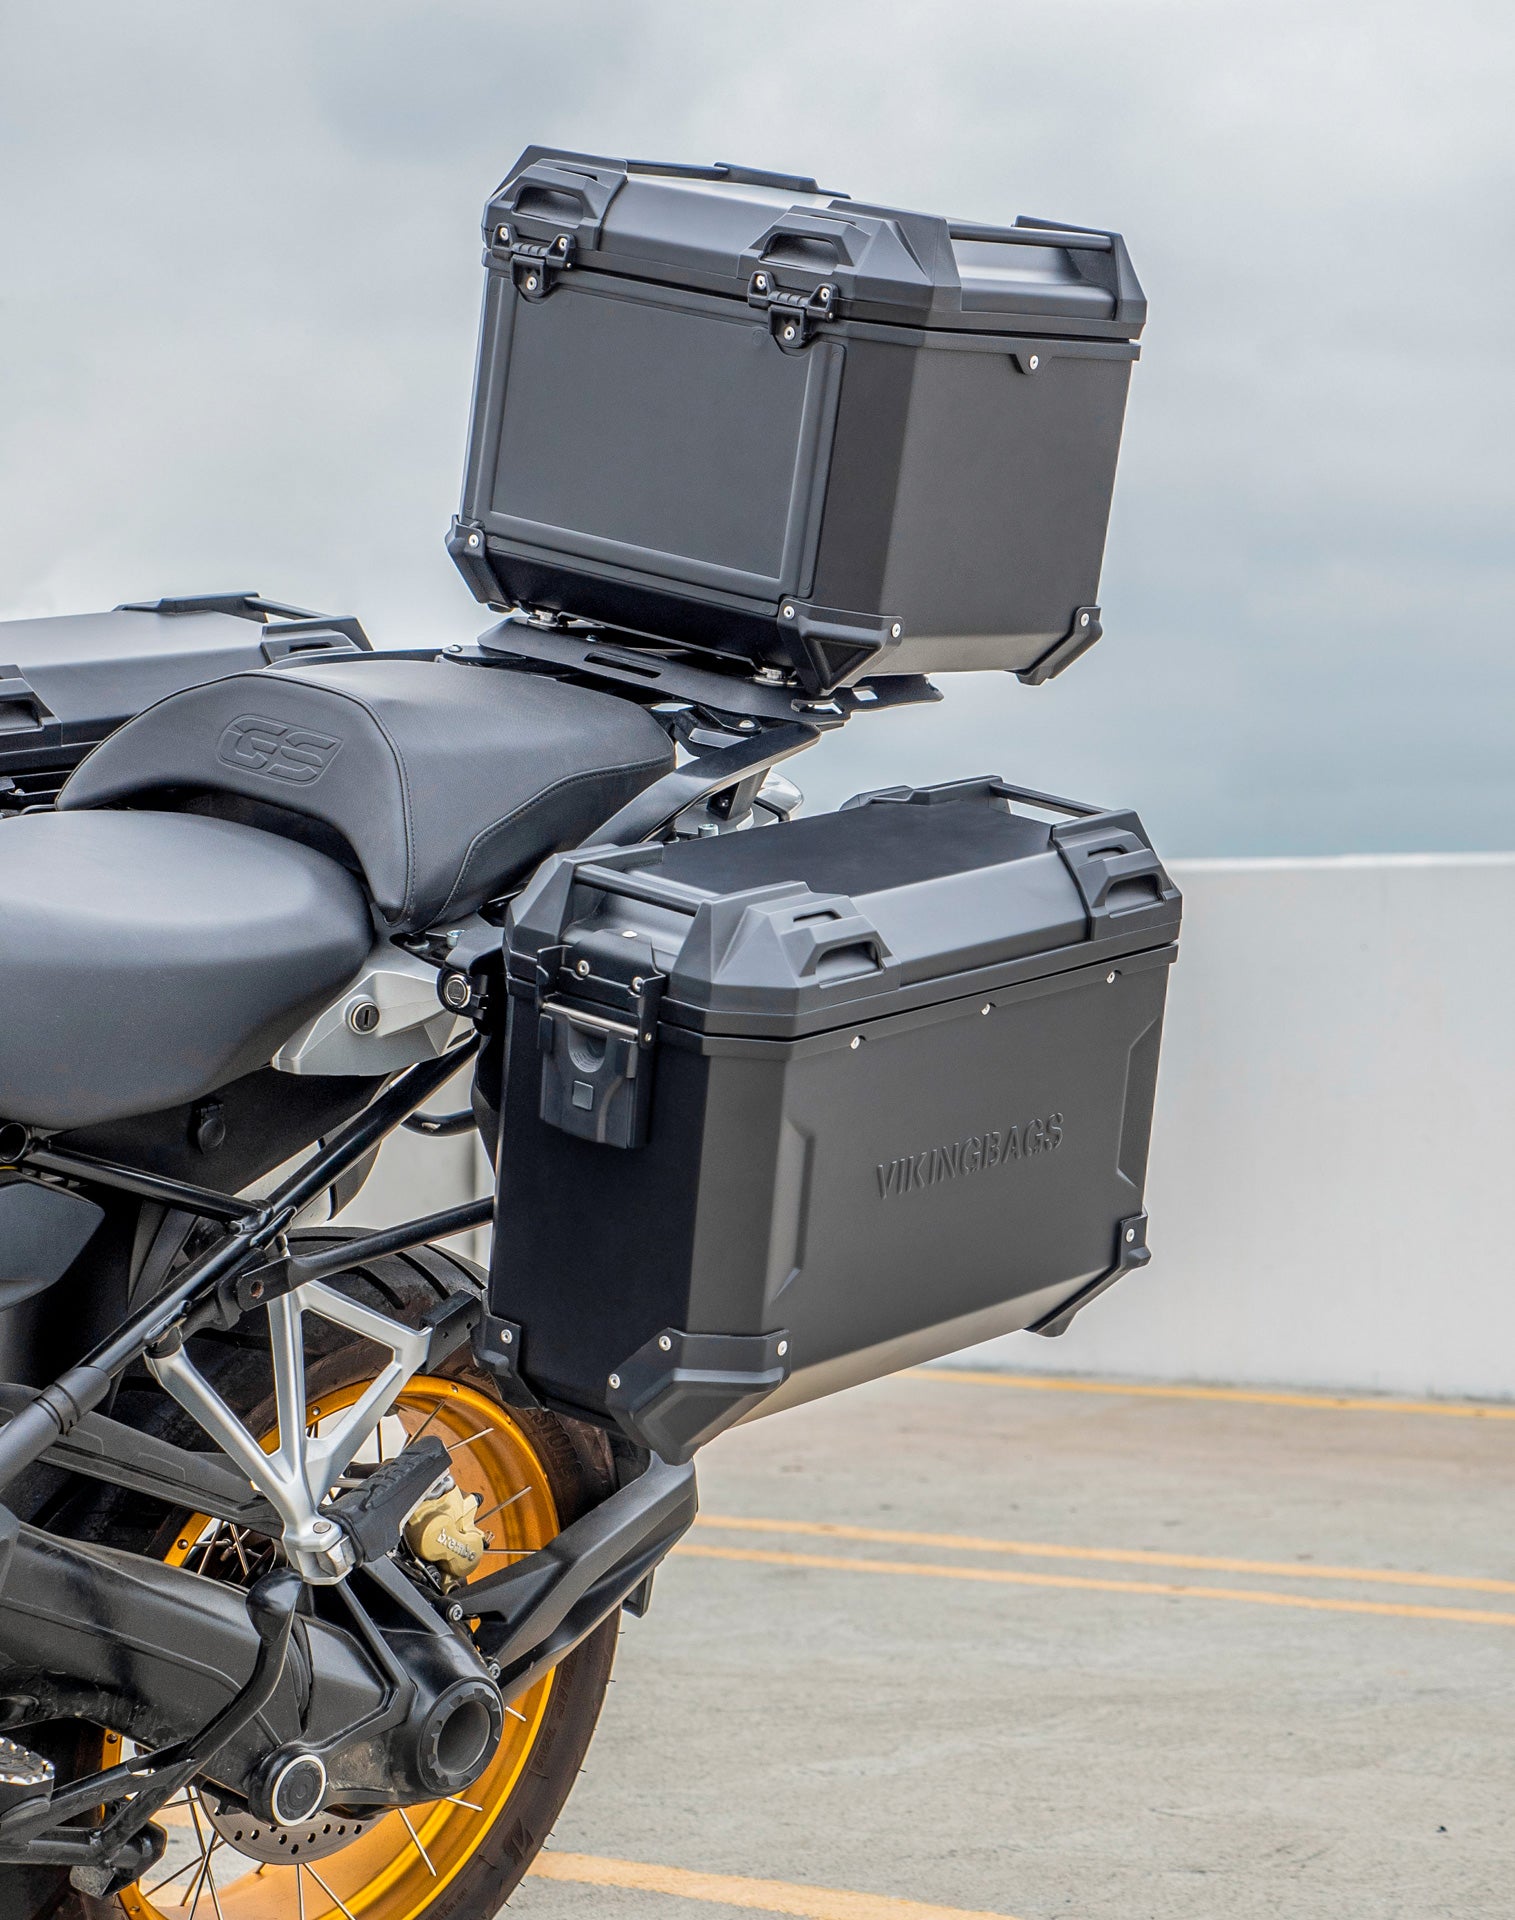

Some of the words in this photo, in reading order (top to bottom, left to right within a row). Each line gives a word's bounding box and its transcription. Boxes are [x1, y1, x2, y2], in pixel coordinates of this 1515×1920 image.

[219, 716, 338, 783] GS
[876, 1112, 1064, 1201] VIKINGBAGS
[436, 1527, 476, 1561] brembo
